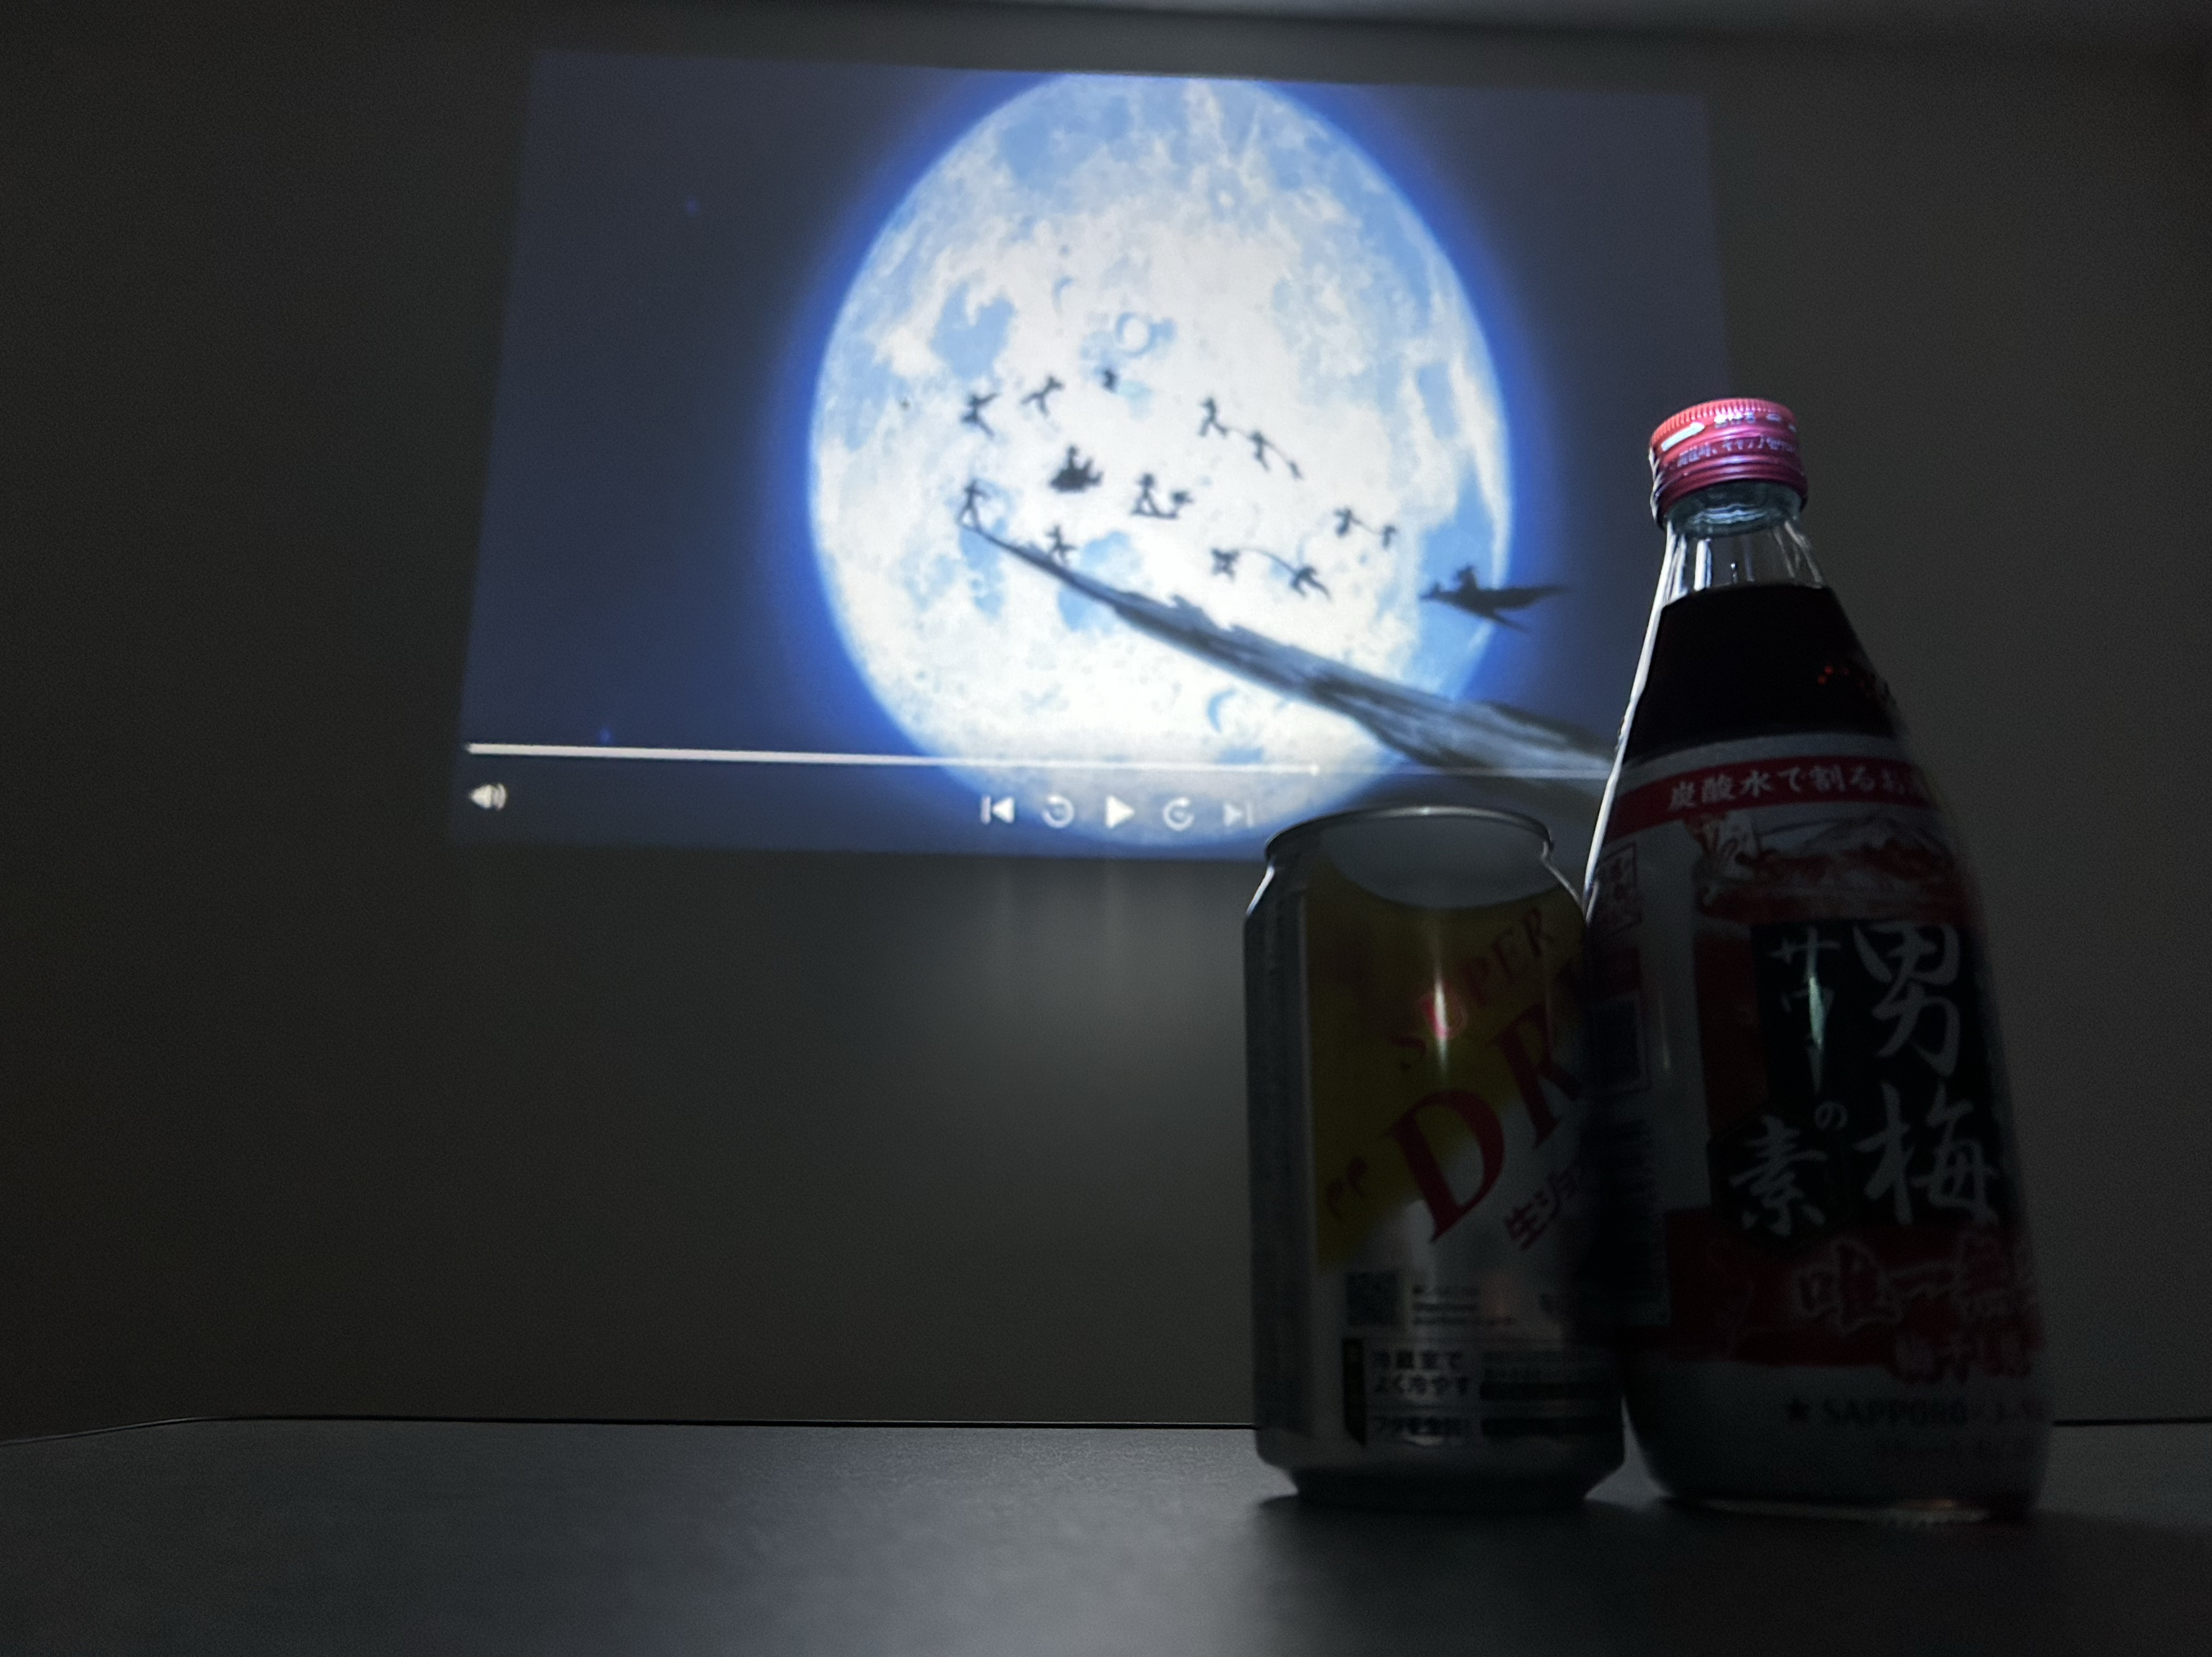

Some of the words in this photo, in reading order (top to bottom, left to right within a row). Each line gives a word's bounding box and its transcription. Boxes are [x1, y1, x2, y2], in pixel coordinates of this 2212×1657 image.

[1387, 906, 1555, 1072] SUPER
[1852, 922, 2002, 1226] 男梅
[1822, 1397, 1969, 1427] SAPPORO
